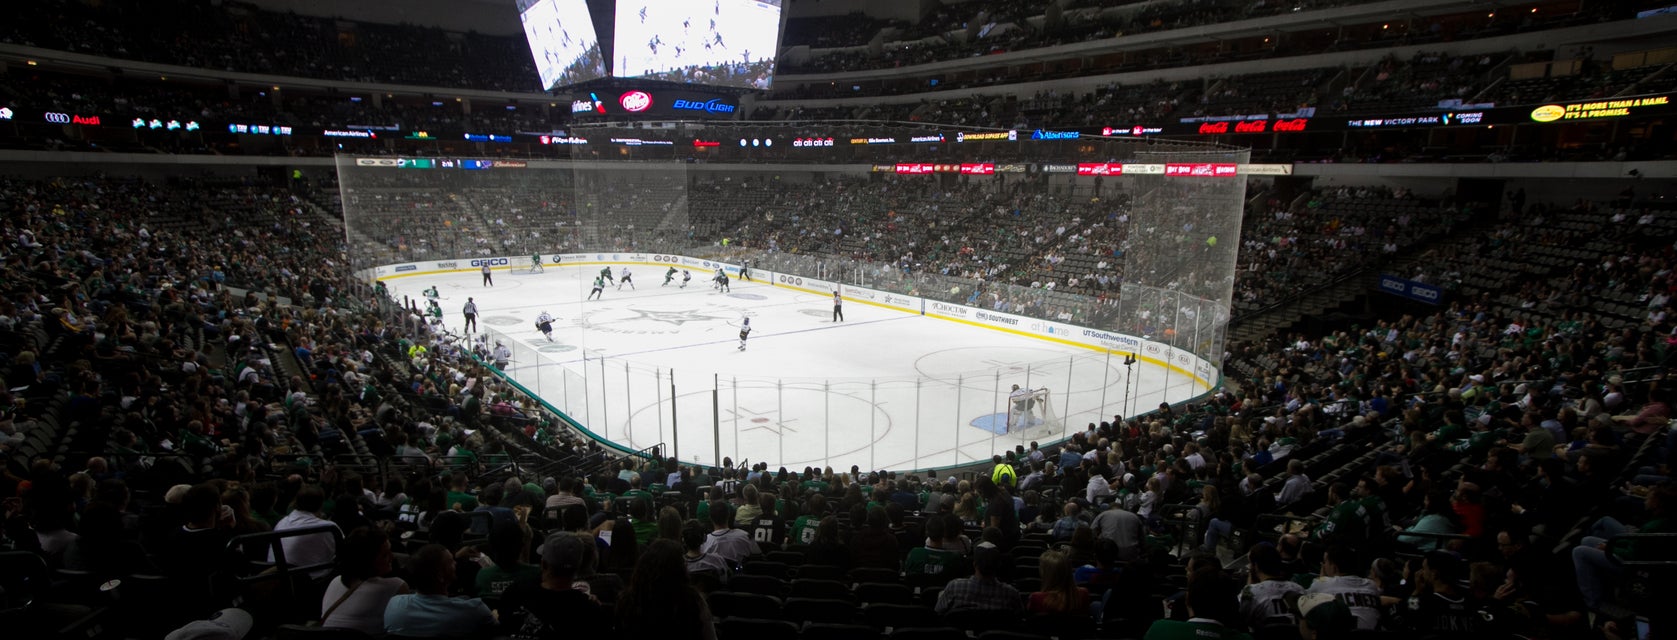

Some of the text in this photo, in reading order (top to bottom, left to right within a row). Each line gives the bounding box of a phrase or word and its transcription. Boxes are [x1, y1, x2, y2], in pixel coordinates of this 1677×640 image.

[673, 99, 735, 113] BUD LIGHT
[1582, 102, 1608, 110] MORE
[1608, 100, 1633, 108] THAN
[73, 115, 100, 124] Audi
[1565, 111, 1580, 119] IT'S
[1384, 117, 1417, 125] VICTORY
[1045, 131, 1080, 139] Albertsons
[471, 258, 508, 267] GEICO
[1382, 279, 1405, 292] GEICO
[1411, 285, 1438, 300] GEICO
[989, 314, 1019, 325] SOUTHWEST
